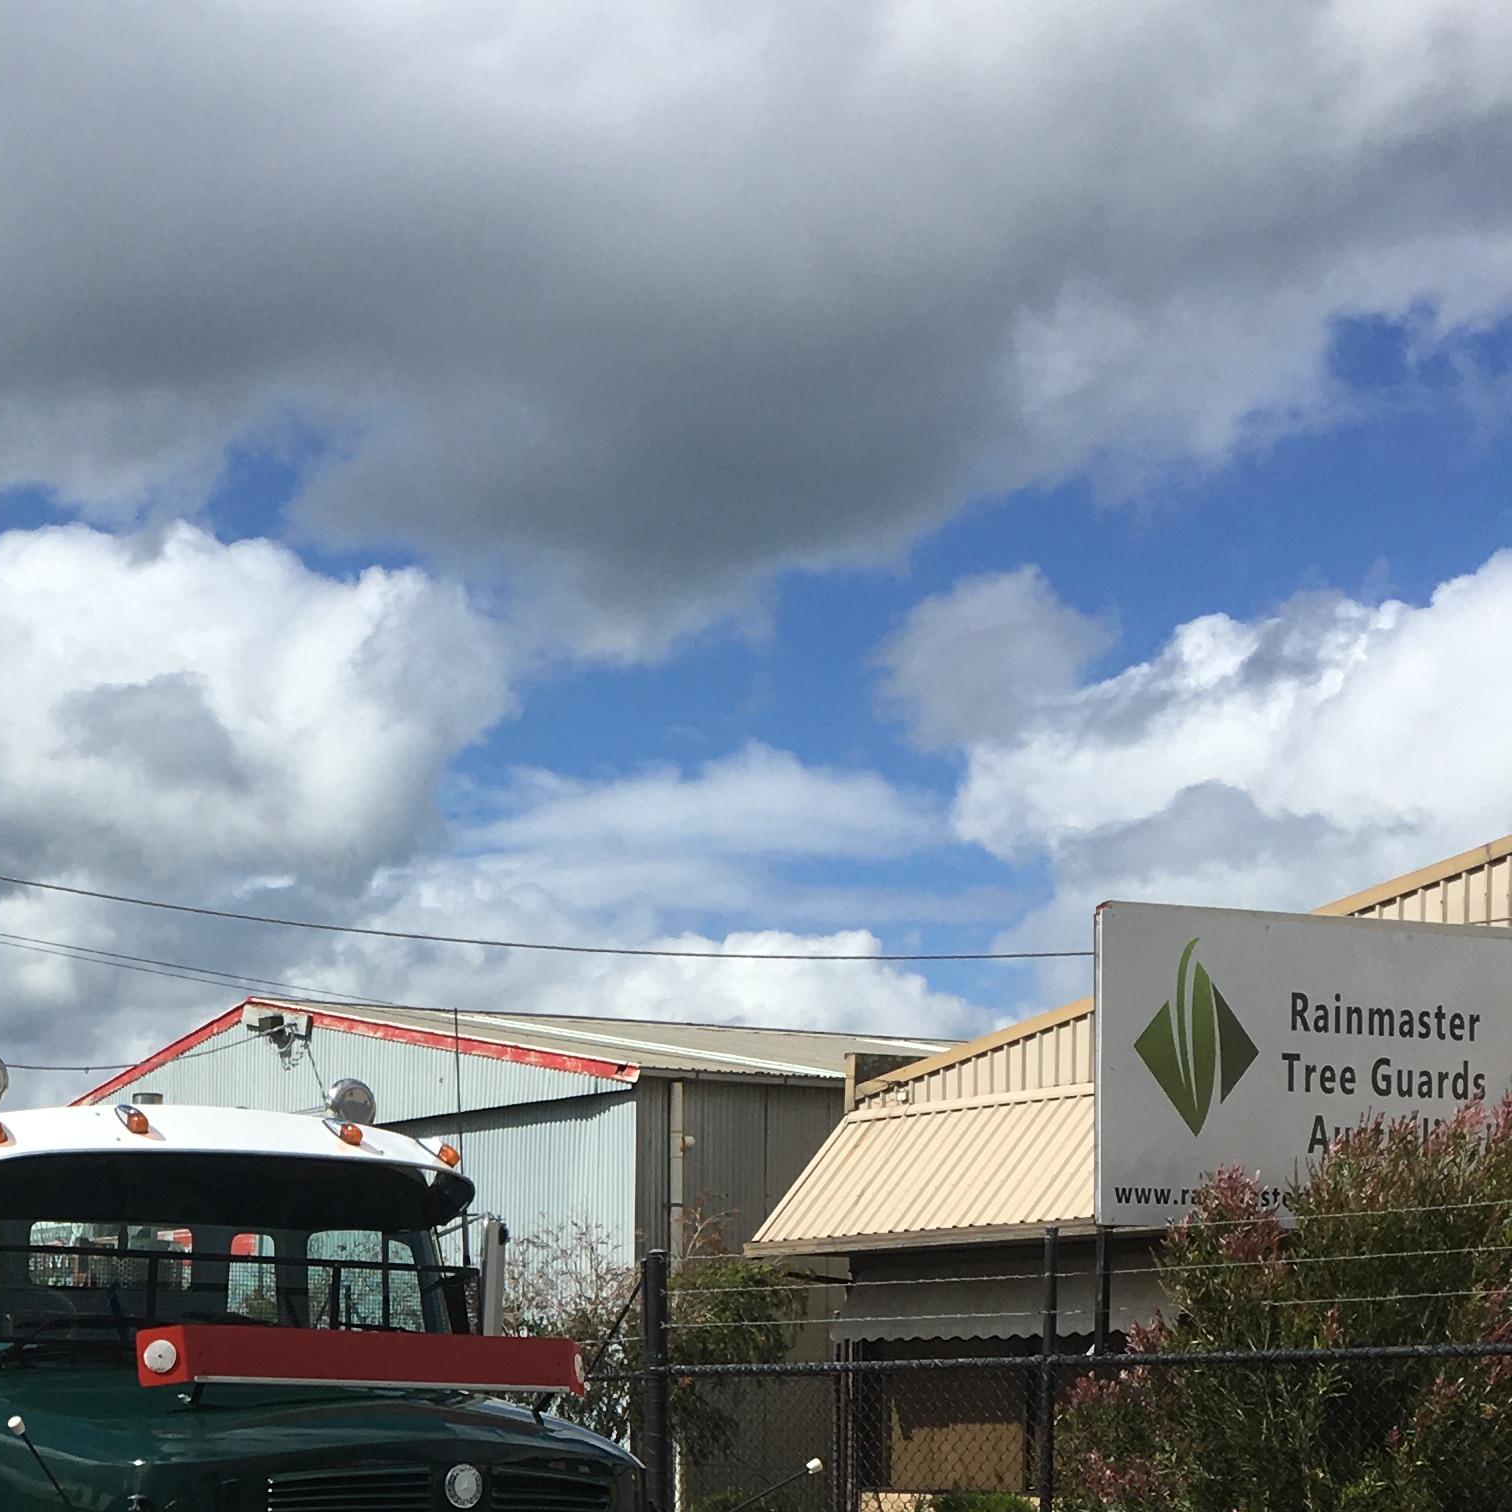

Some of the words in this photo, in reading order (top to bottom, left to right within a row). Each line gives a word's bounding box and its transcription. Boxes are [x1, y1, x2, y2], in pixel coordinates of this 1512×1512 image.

[1291, 991, 1481, 1042] Rainmaster
[1281, 1052, 1357, 1096] Tree
[1371, 1057, 1486, 1101] Guards
